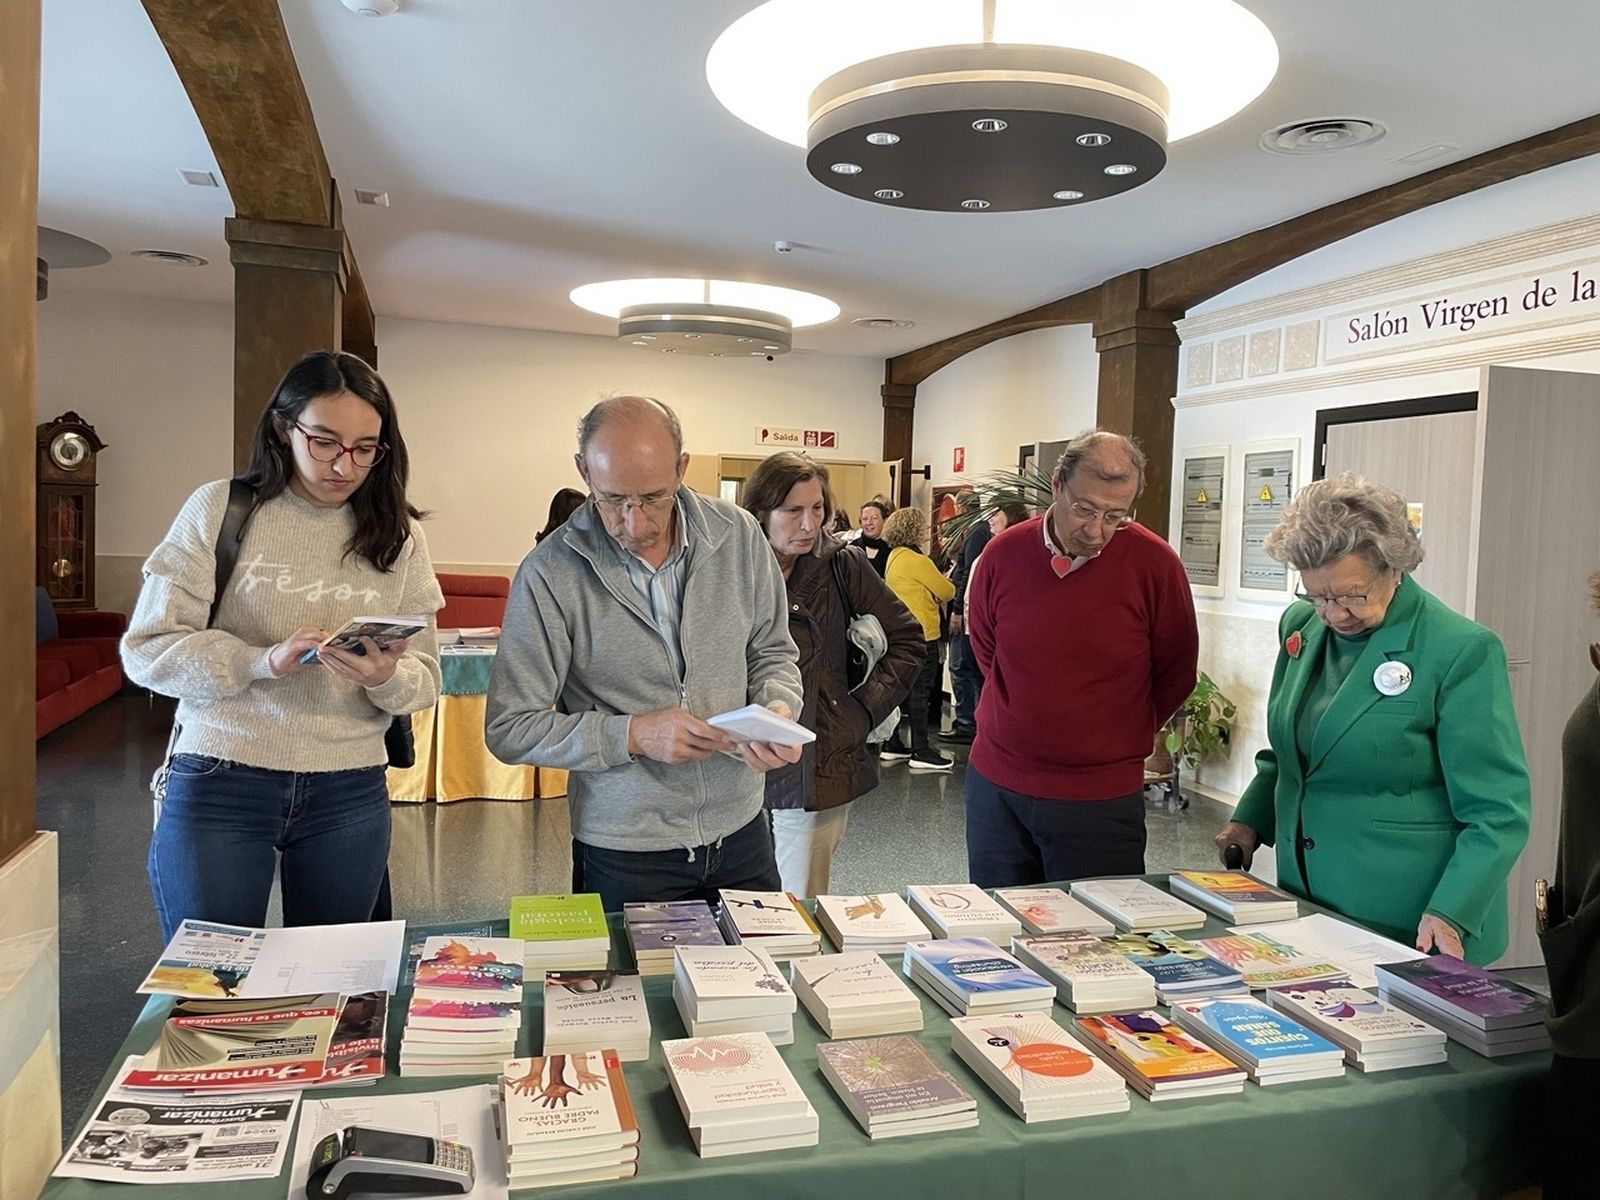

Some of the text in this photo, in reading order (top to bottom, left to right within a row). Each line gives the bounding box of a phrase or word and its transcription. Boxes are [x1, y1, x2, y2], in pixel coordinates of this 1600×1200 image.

[1347, 270, 1598, 344] Salón Virgen de la
[773, 432, 799, 442] Salida
[556, 997, 615, 1011] persuasión
[272, 1010, 299, 1019] que
[302, 1009, 329, 1018] Lee,
[178, 1016, 253, 1026] humanizas
[1251, 1029, 1282, 1038] QUE
[1244, 1033, 1310, 1046] CUENTOS
[518, 1112, 561, 1122] BUENO
[563, 1109, 600, 1120] PADRE
[533, 1117, 587, 1127] GRACIAS,
